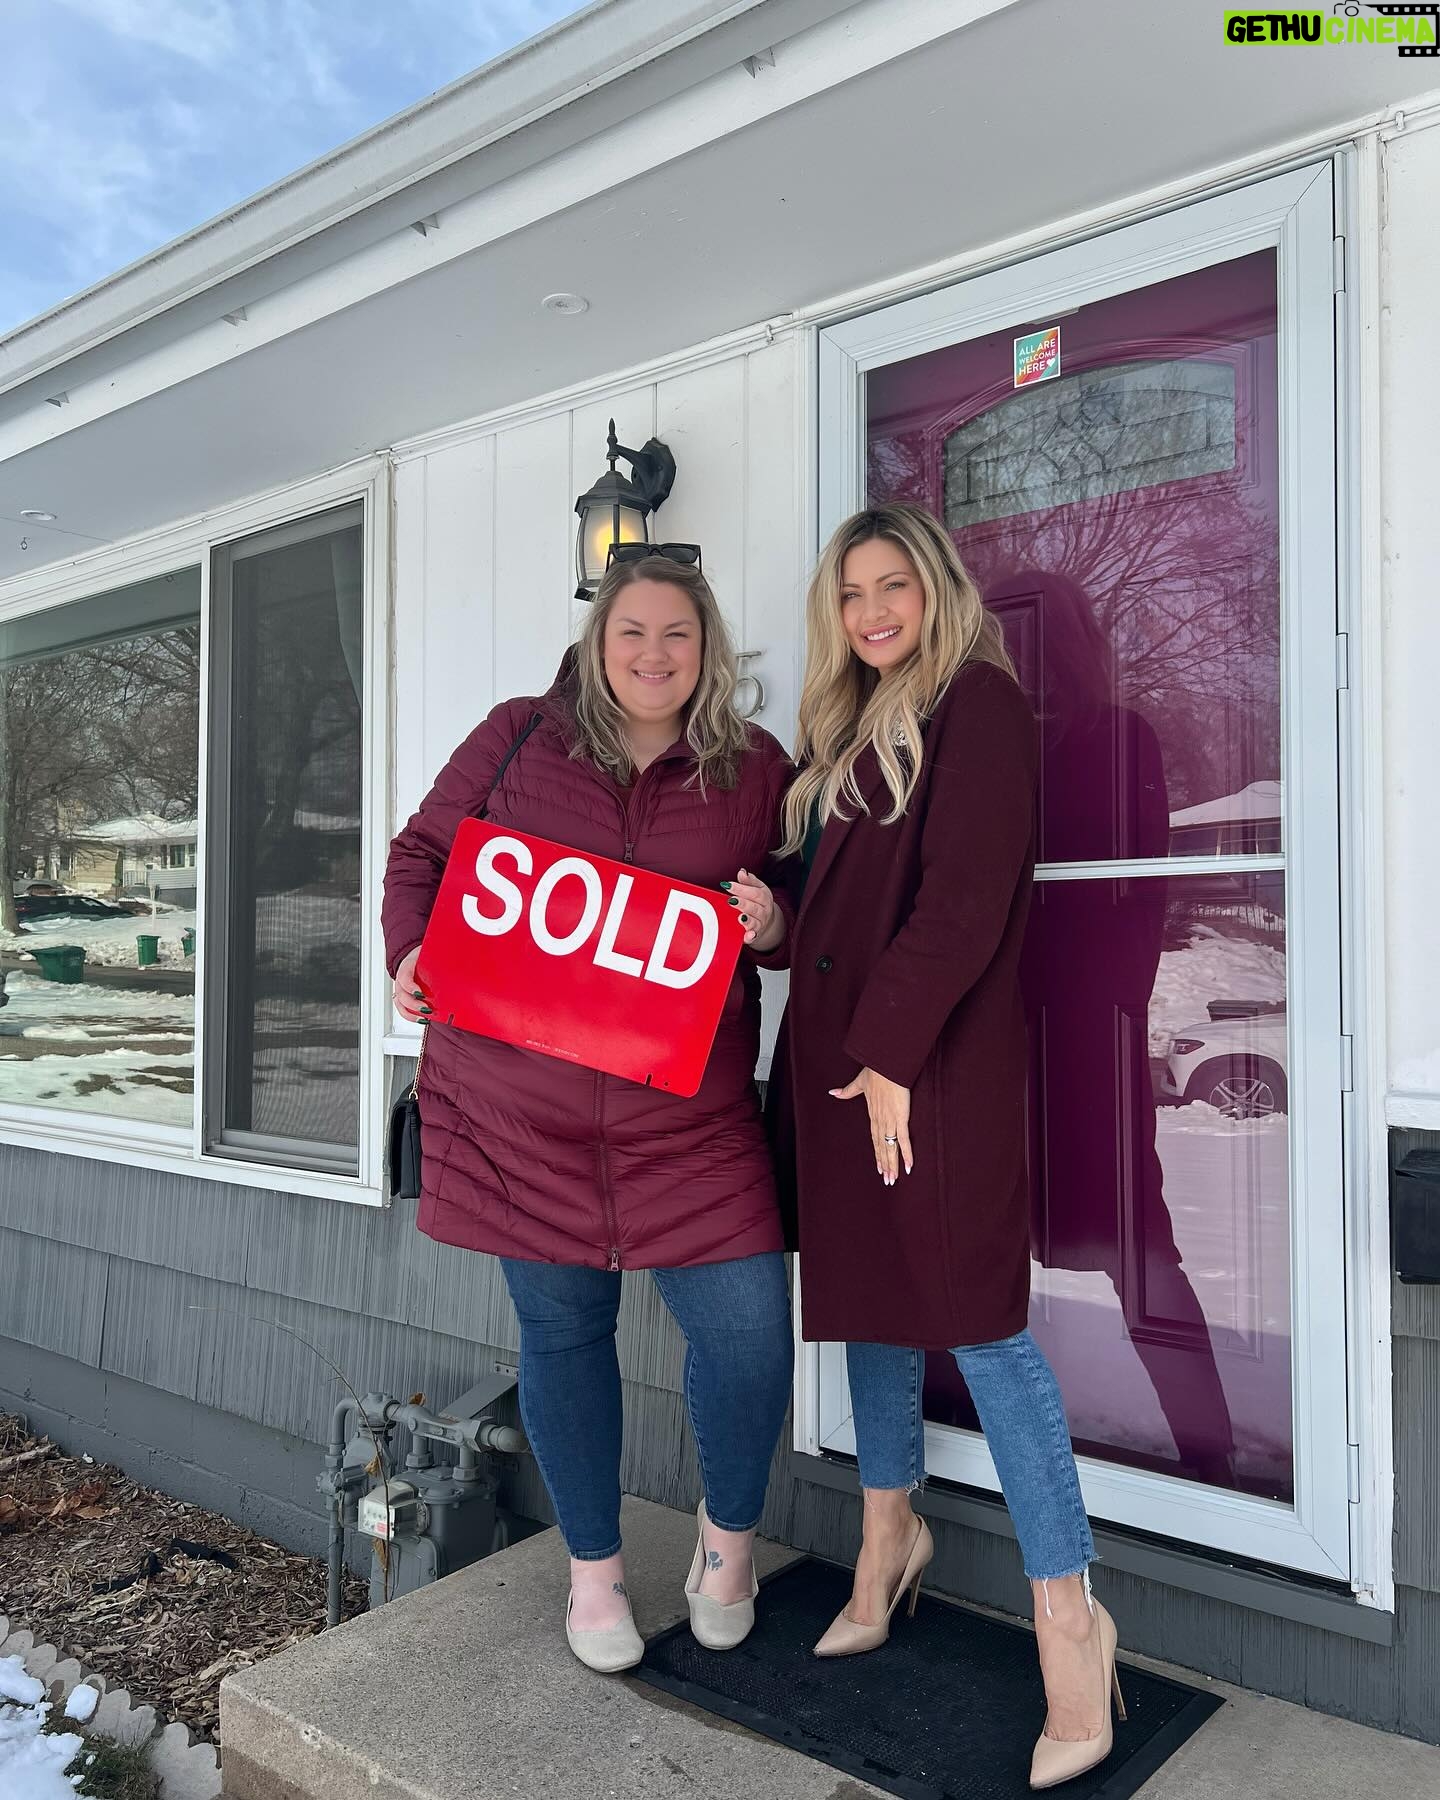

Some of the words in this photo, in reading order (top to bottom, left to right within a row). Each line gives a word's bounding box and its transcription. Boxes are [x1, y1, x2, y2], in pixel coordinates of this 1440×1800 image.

[1018, 344, 1036, 357] ALL
[1037, 338, 1056, 352] ARE
[1018, 348, 1056, 365] WELCOME
[1018, 360, 1046, 377] HERE
[461, 835, 720, 990] SOLD
